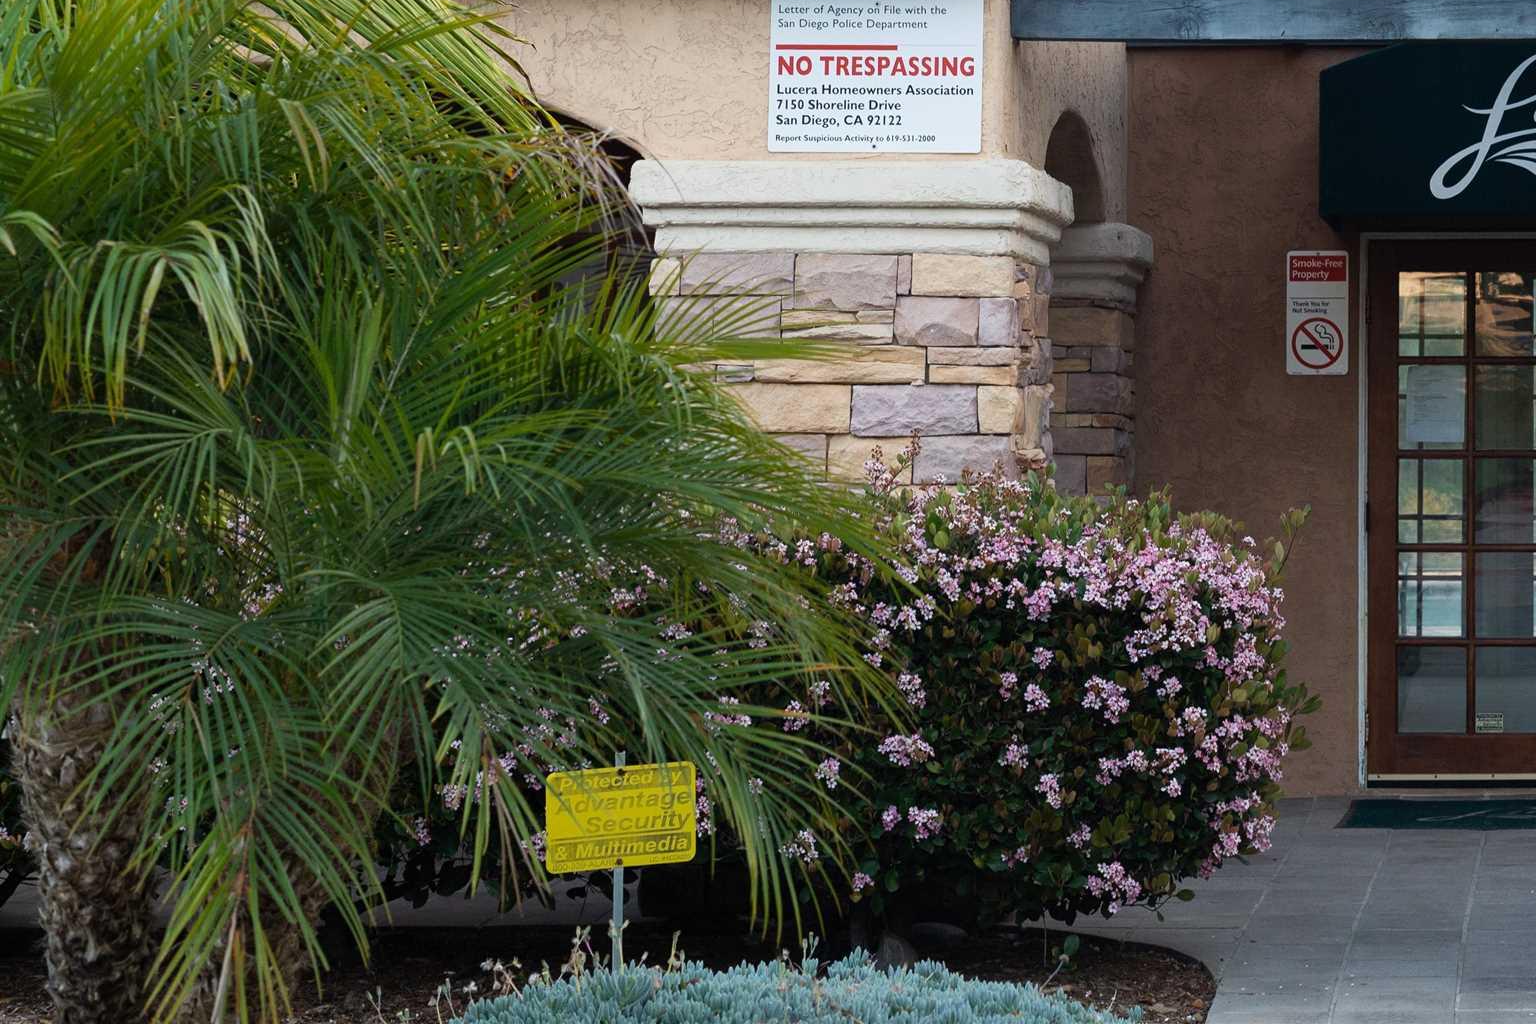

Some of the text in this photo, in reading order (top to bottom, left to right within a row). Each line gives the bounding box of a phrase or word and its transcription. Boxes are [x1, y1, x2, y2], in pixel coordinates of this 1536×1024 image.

[778, 4, 947, 17] Letter of Agency on File with the
[778, 18, 928, 31] San Diego Police Department
[777, 55, 975, 77] NO TRESPASSING
[776, 84, 974, 96] Lucera Homeowners Association
[776, 99, 902, 111] 7150 Shoreline Drive
[776, 114, 902, 128] San Diego, CA 92122
[775, 134, 801, 143] Report
[804, 134, 843, 143] Suspicious
[844, 134, 874, 143] Activity
[886, 134, 936, 142] 619-531-2000
[1292, 258, 1343, 268] Smoke-Free
[1292, 270, 1329, 281] Property
[555, 791, 691, 815] Advantage
[586, 810, 692, 834] Security
[555, 835, 688, 861] & Multimedia
